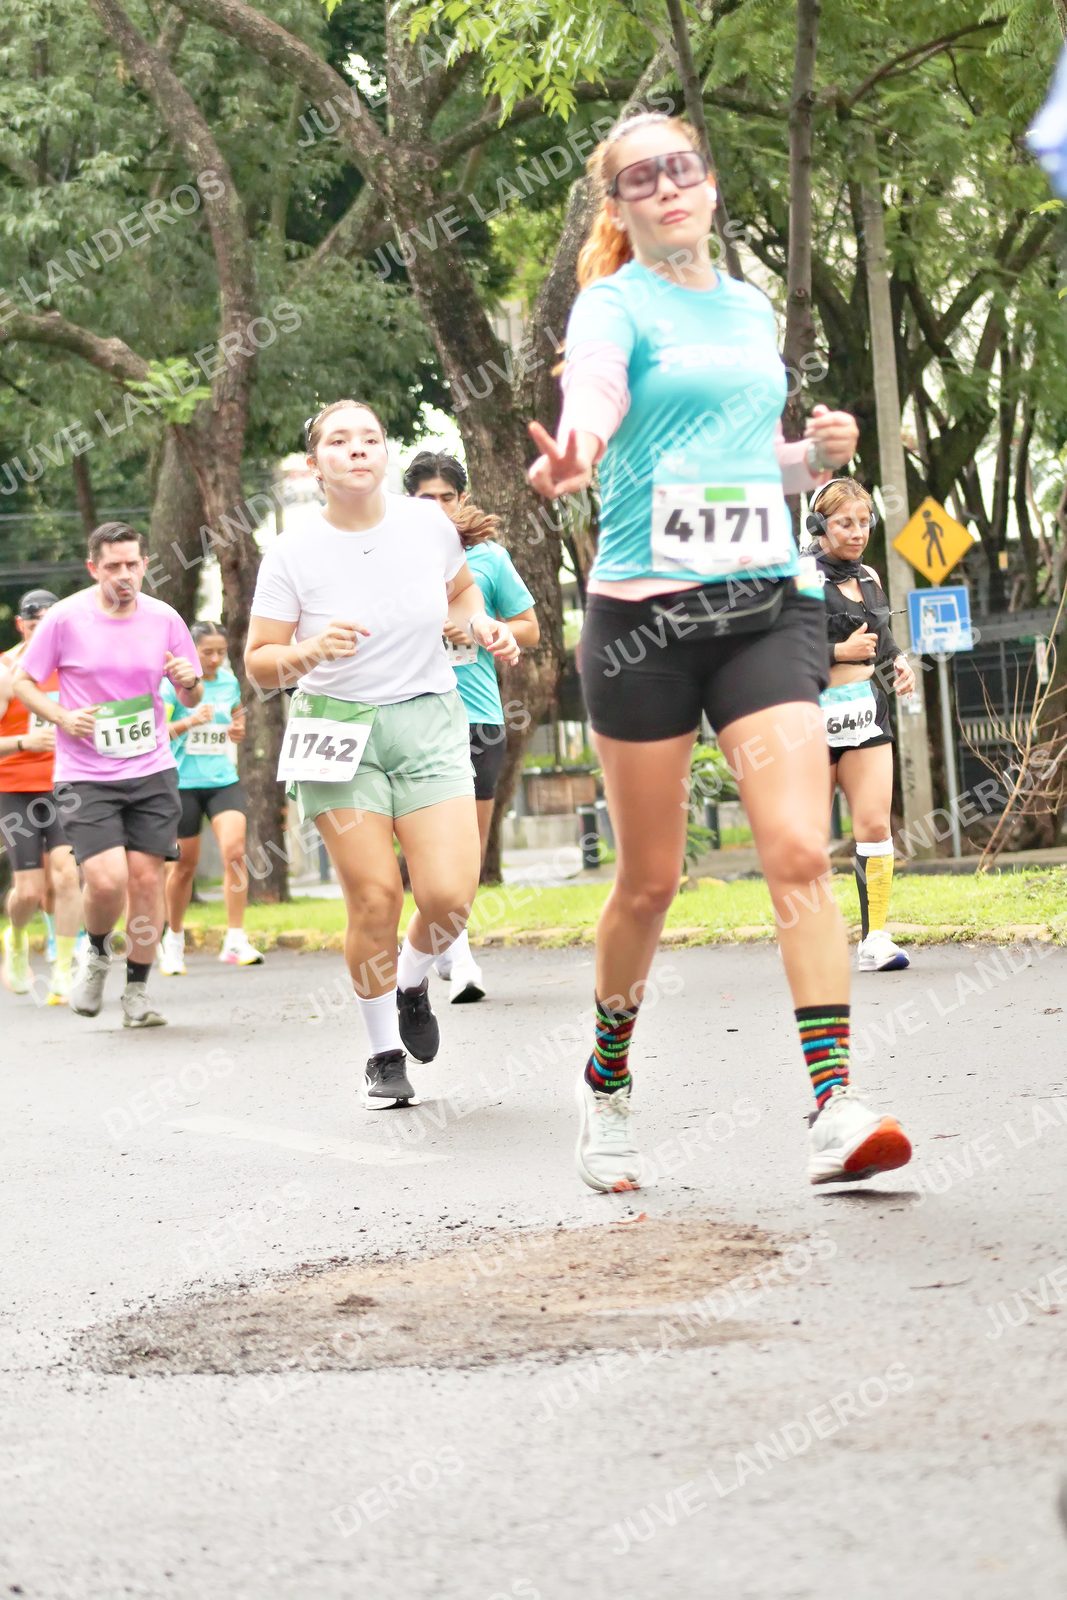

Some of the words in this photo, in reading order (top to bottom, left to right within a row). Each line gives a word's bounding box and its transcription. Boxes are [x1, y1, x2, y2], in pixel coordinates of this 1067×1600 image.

[664, 507, 769, 542] 4171
[101, 720, 151, 746] 1166
[826, 709, 873, 734] 6449
[191, 731, 226, 744] 3198
[288, 733, 358, 763] 1742
